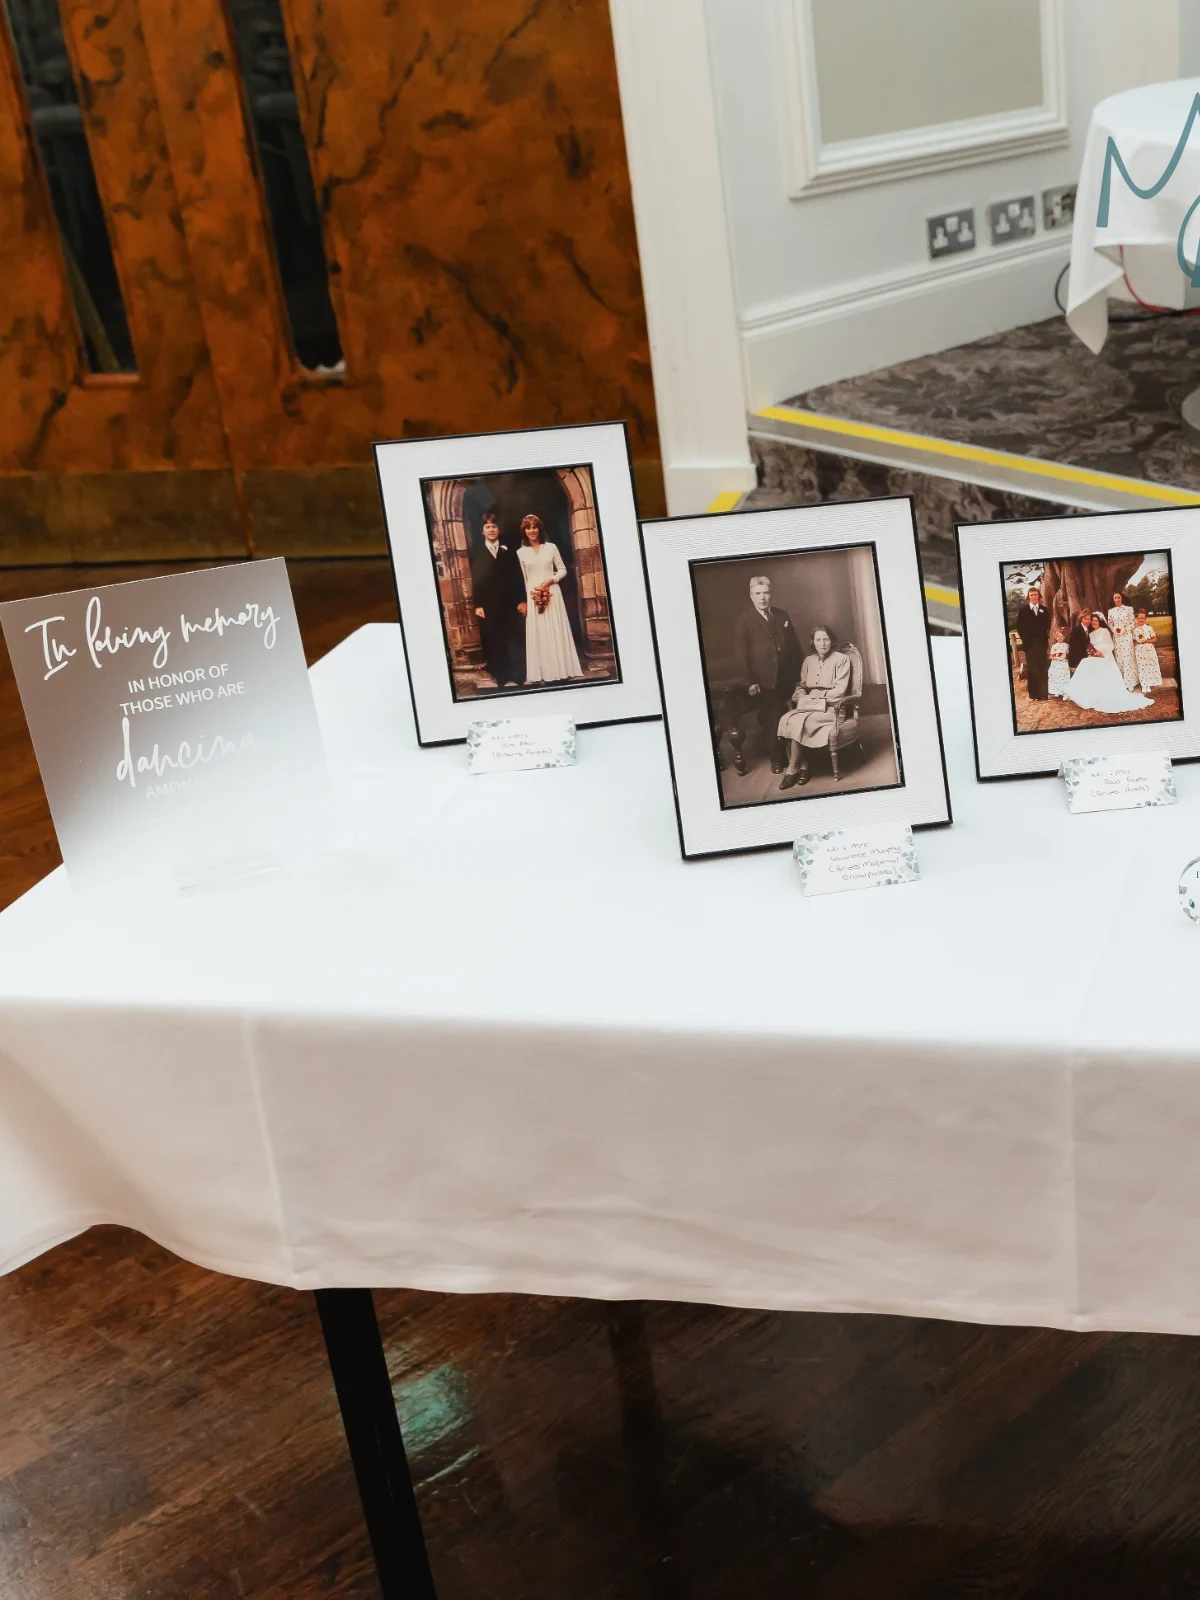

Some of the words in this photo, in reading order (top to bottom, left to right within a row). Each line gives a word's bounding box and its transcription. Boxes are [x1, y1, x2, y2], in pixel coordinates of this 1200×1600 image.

[25, 616, 76, 680] In
[86, 596, 171, 669] loving
[181, 603, 281, 650] memory
[127, 679, 145, 694] IN
[148, 668, 206, 690] HONOR
[209, 663, 229, 679] OF
[119, 695, 173, 716] THOSE
[175, 687, 214, 706] WHO
[217, 681, 247, 698] ARE
